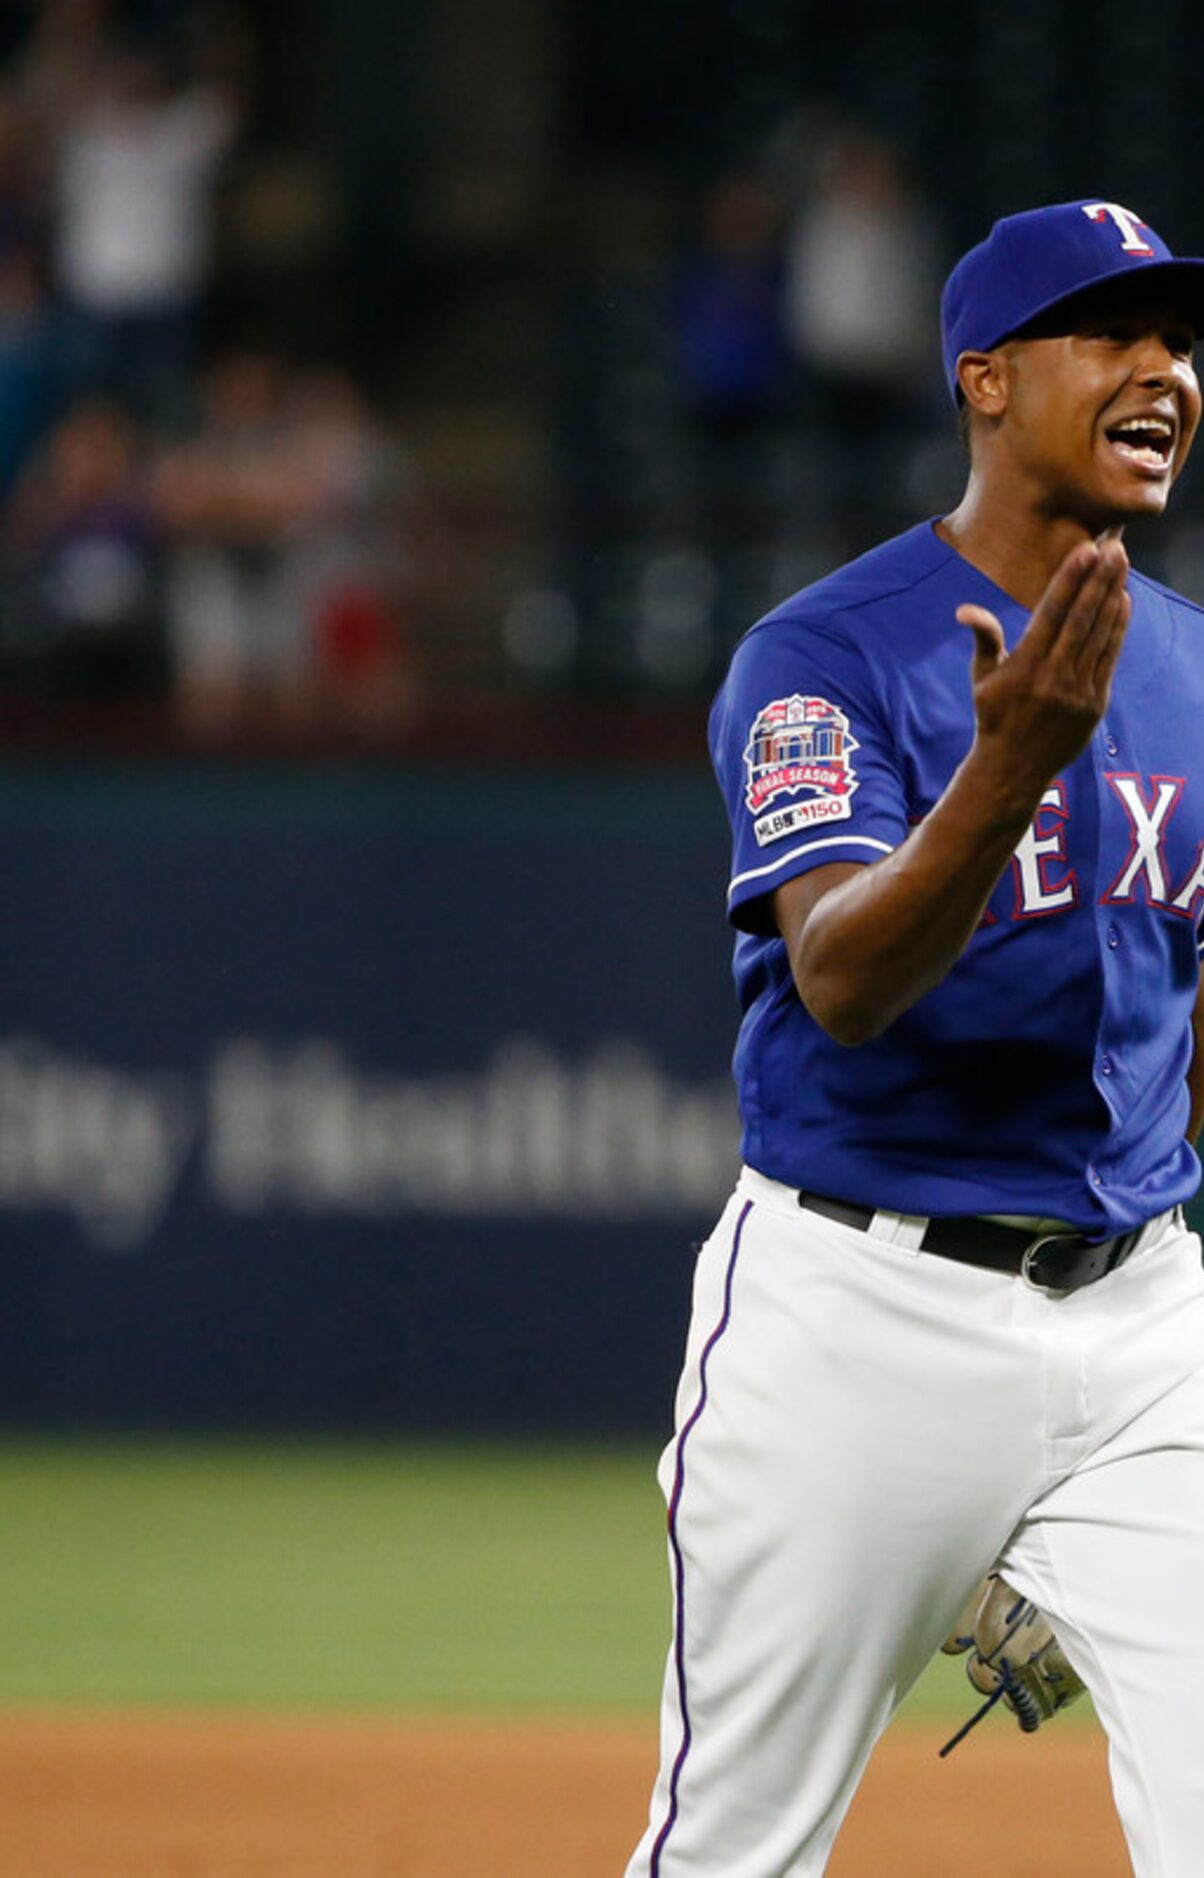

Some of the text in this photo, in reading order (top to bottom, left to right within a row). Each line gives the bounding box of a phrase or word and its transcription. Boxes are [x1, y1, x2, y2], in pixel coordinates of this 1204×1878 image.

[1081, 203, 1154, 257] T
[755, 766, 839, 796] FINAL SEASON
[757, 801, 842, 837] MLB 150
